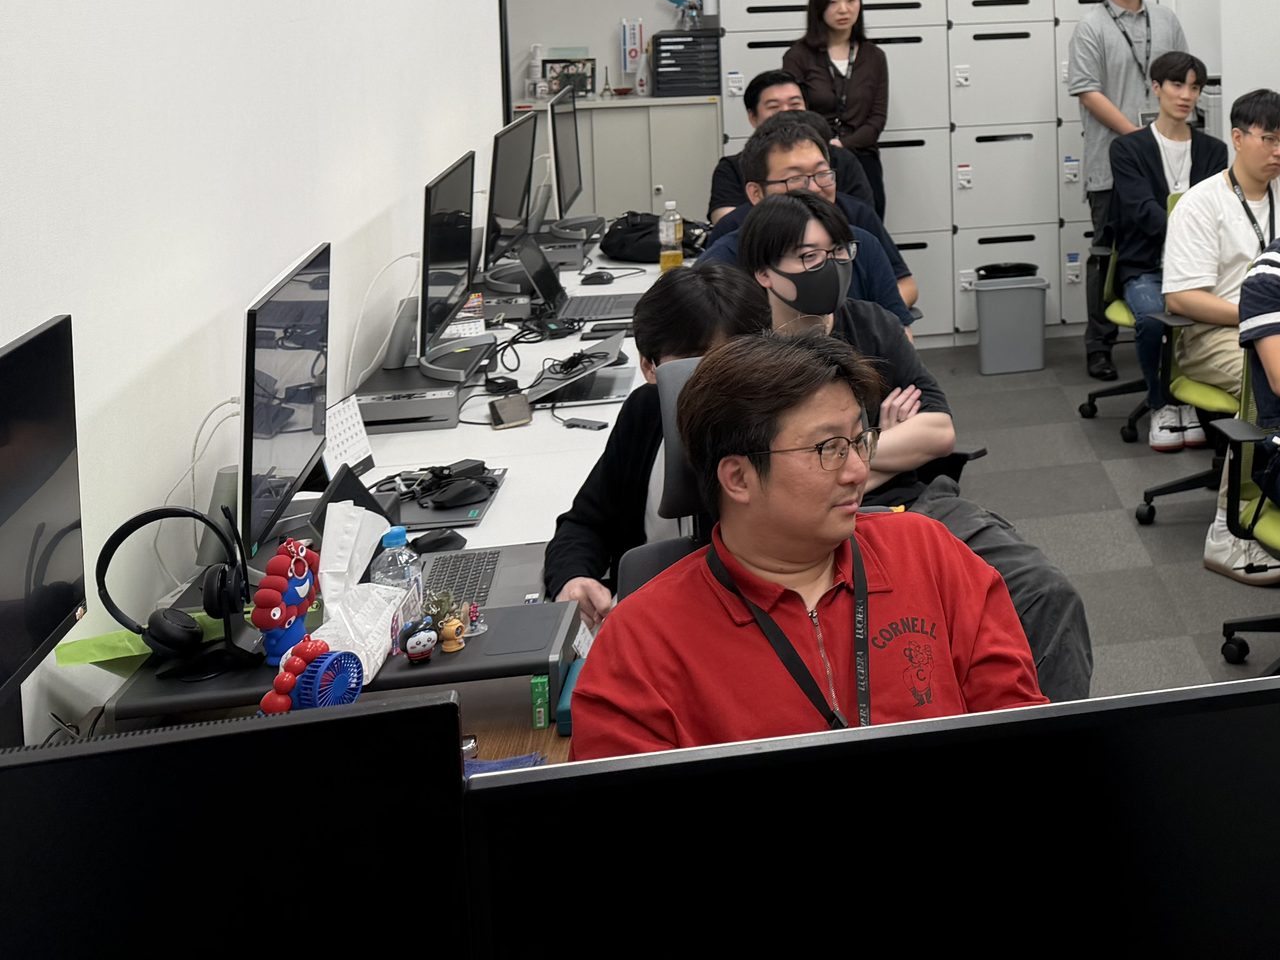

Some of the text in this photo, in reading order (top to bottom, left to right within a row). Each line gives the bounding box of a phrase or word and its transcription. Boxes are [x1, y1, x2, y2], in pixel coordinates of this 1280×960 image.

[871, 616, 938, 650] CORNELL
[856, 651, 866, 692] LUCIERA
[916, 669, 927, 681] C
